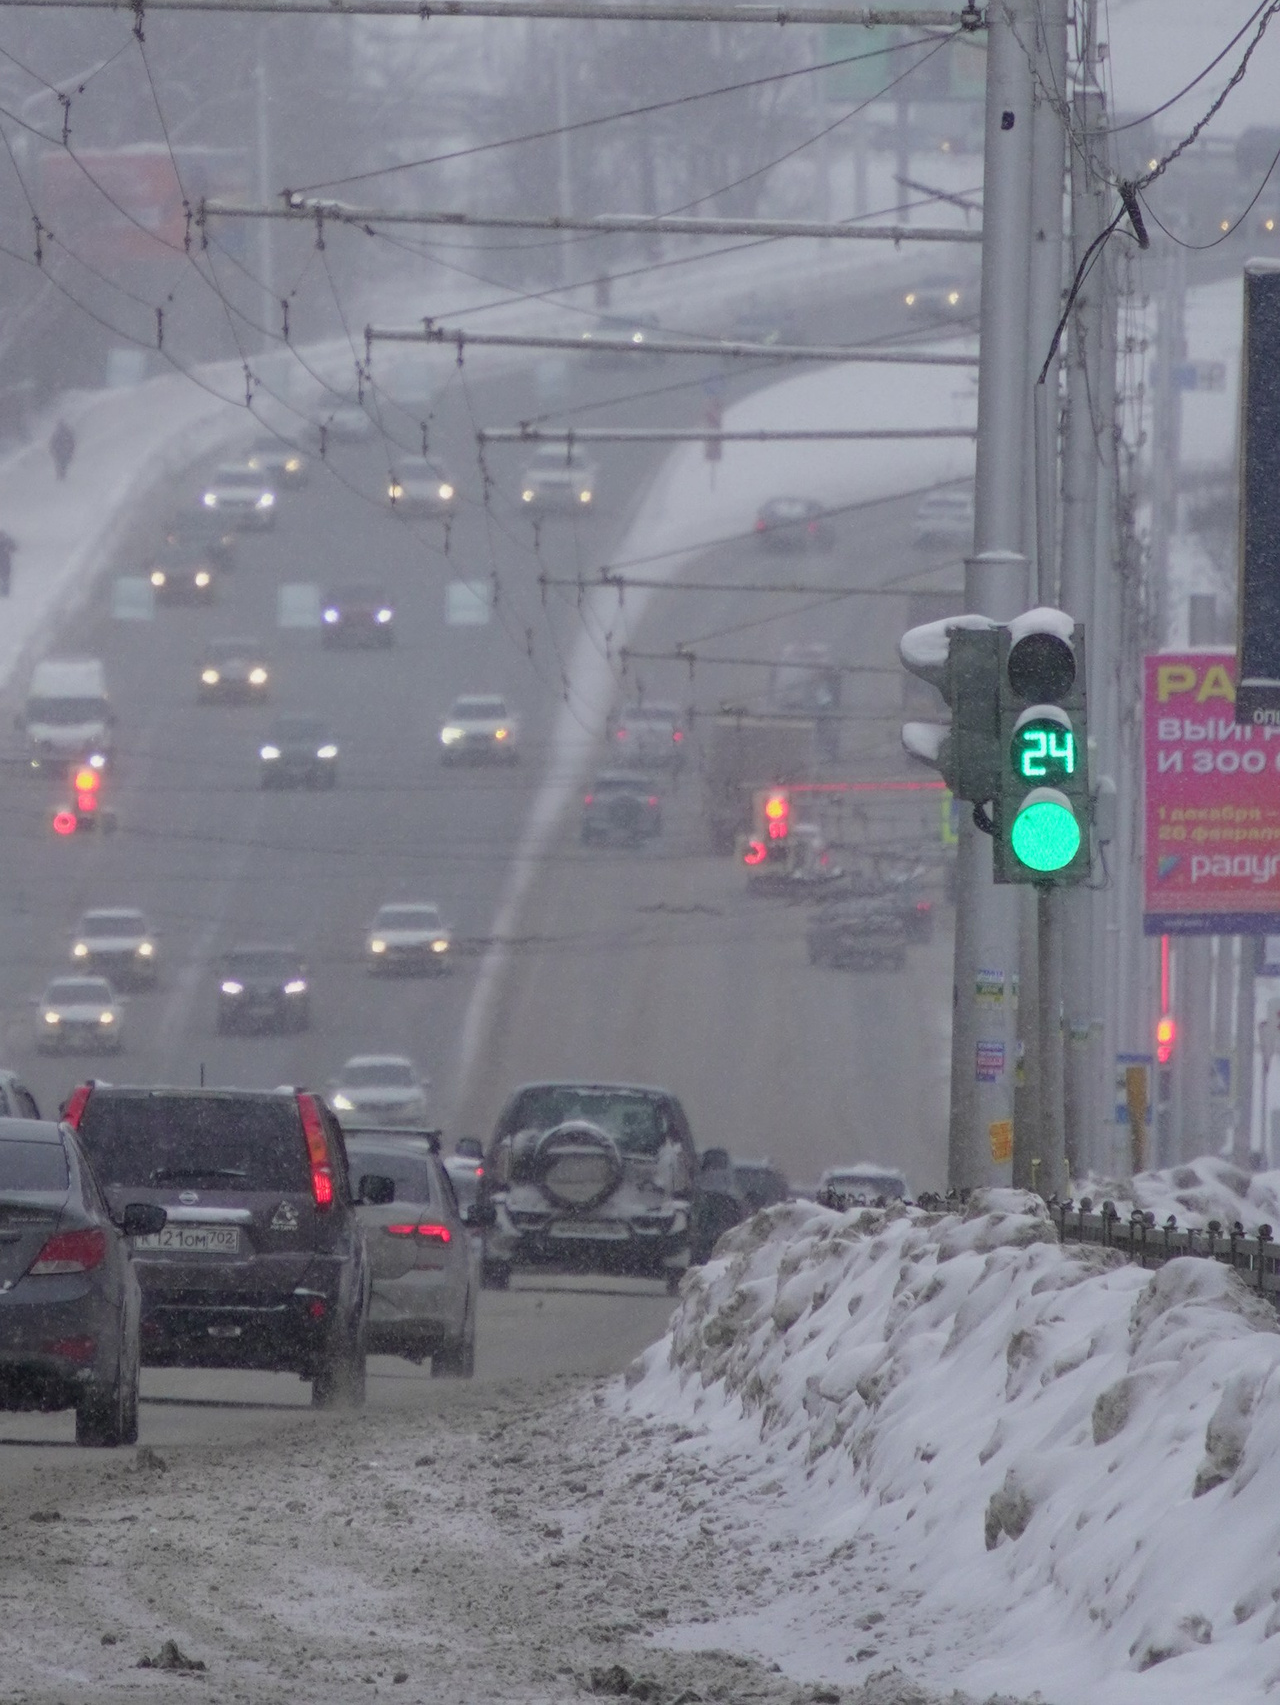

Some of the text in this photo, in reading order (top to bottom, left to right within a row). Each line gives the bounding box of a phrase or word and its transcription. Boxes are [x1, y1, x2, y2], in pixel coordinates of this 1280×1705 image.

[1021, 730, 1074, 776] 24
[1158, 749, 1182, 774] И
[1192, 749, 1266, 774] 300
[1170, 804, 1261, 823] декабря
